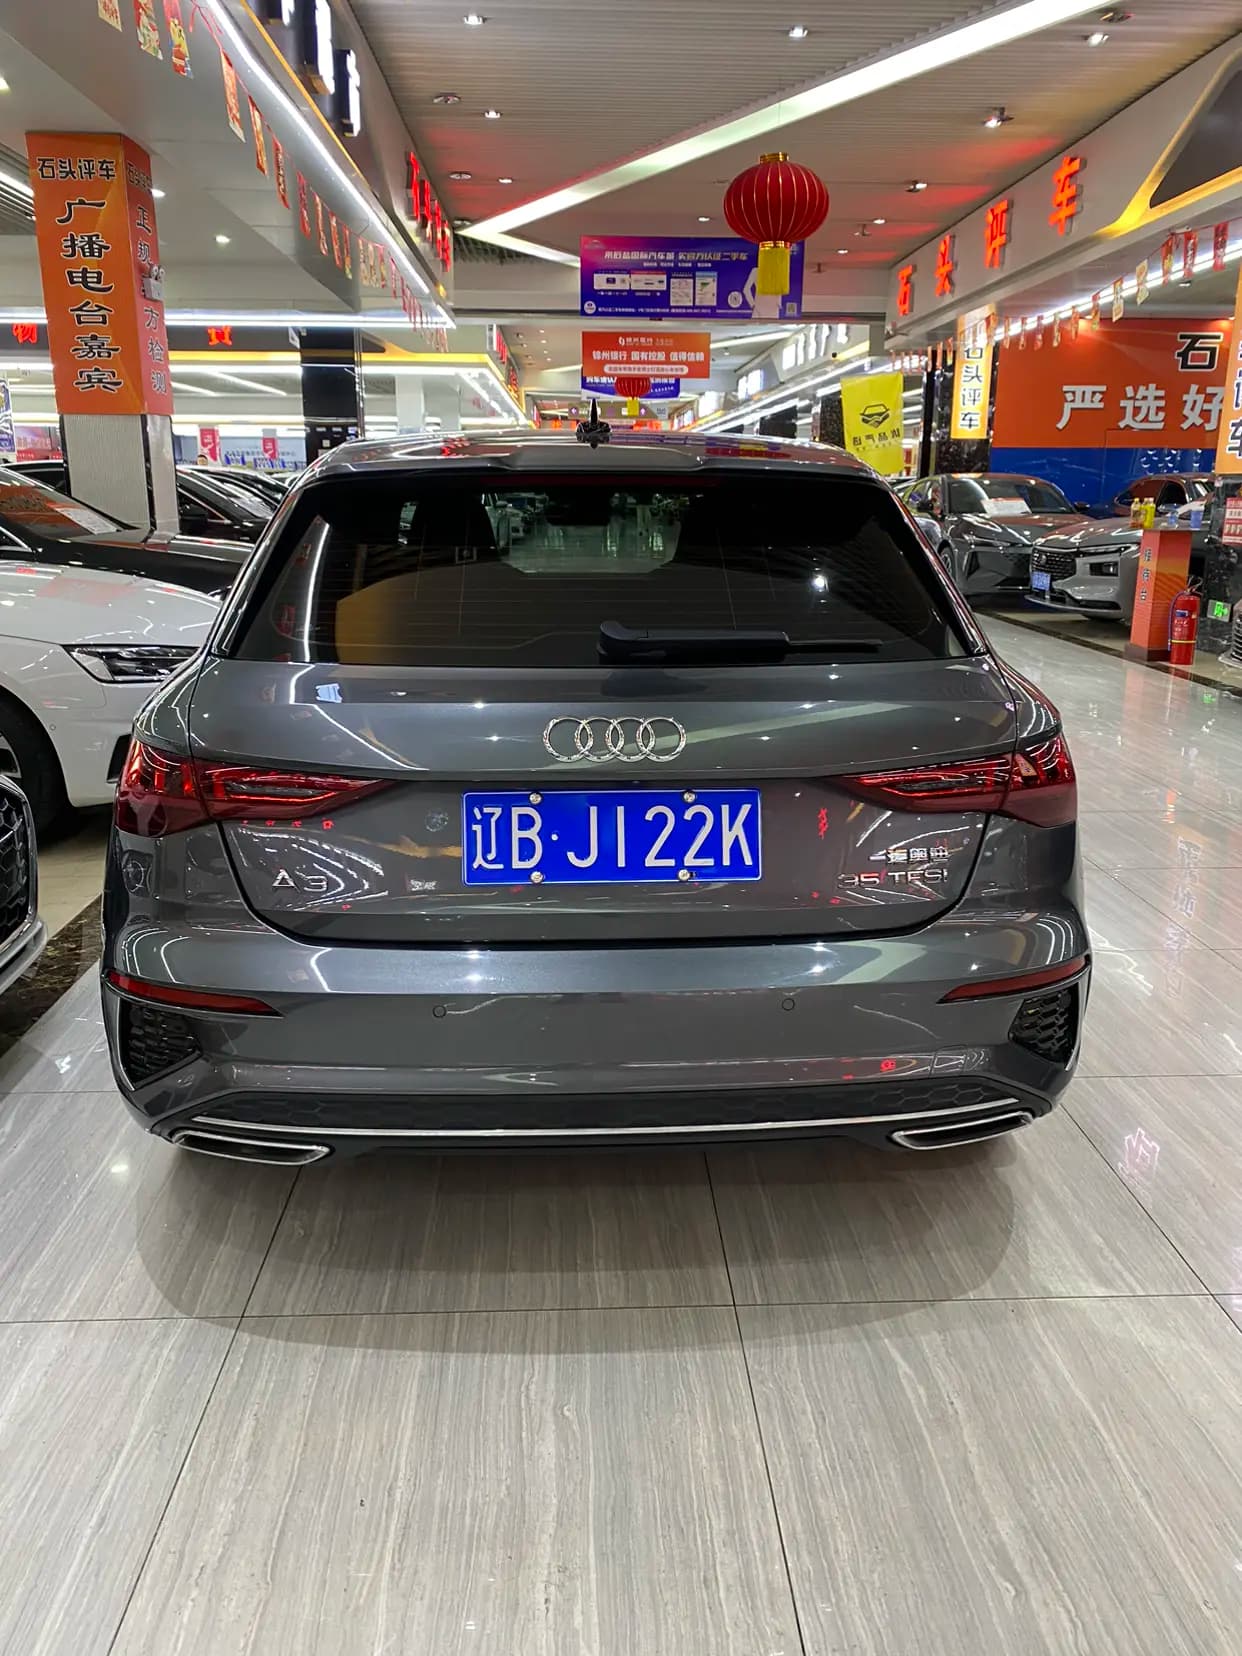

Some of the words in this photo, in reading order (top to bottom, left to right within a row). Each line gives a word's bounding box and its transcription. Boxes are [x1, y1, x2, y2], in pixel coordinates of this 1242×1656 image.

[37, 156, 117, 181] 石头评车
[896, 155, 1084, 317] 石头评车
[55, 197, 124, 394] 广播电台嘉宾
[135, 205, 169, 396] 正规方检测
[1174, 331, 1225, 372] 石
[271, 868, 329, 893] A3
[837, 872, 880, 889] 35
[887, 868, 948, 885] TFSI
